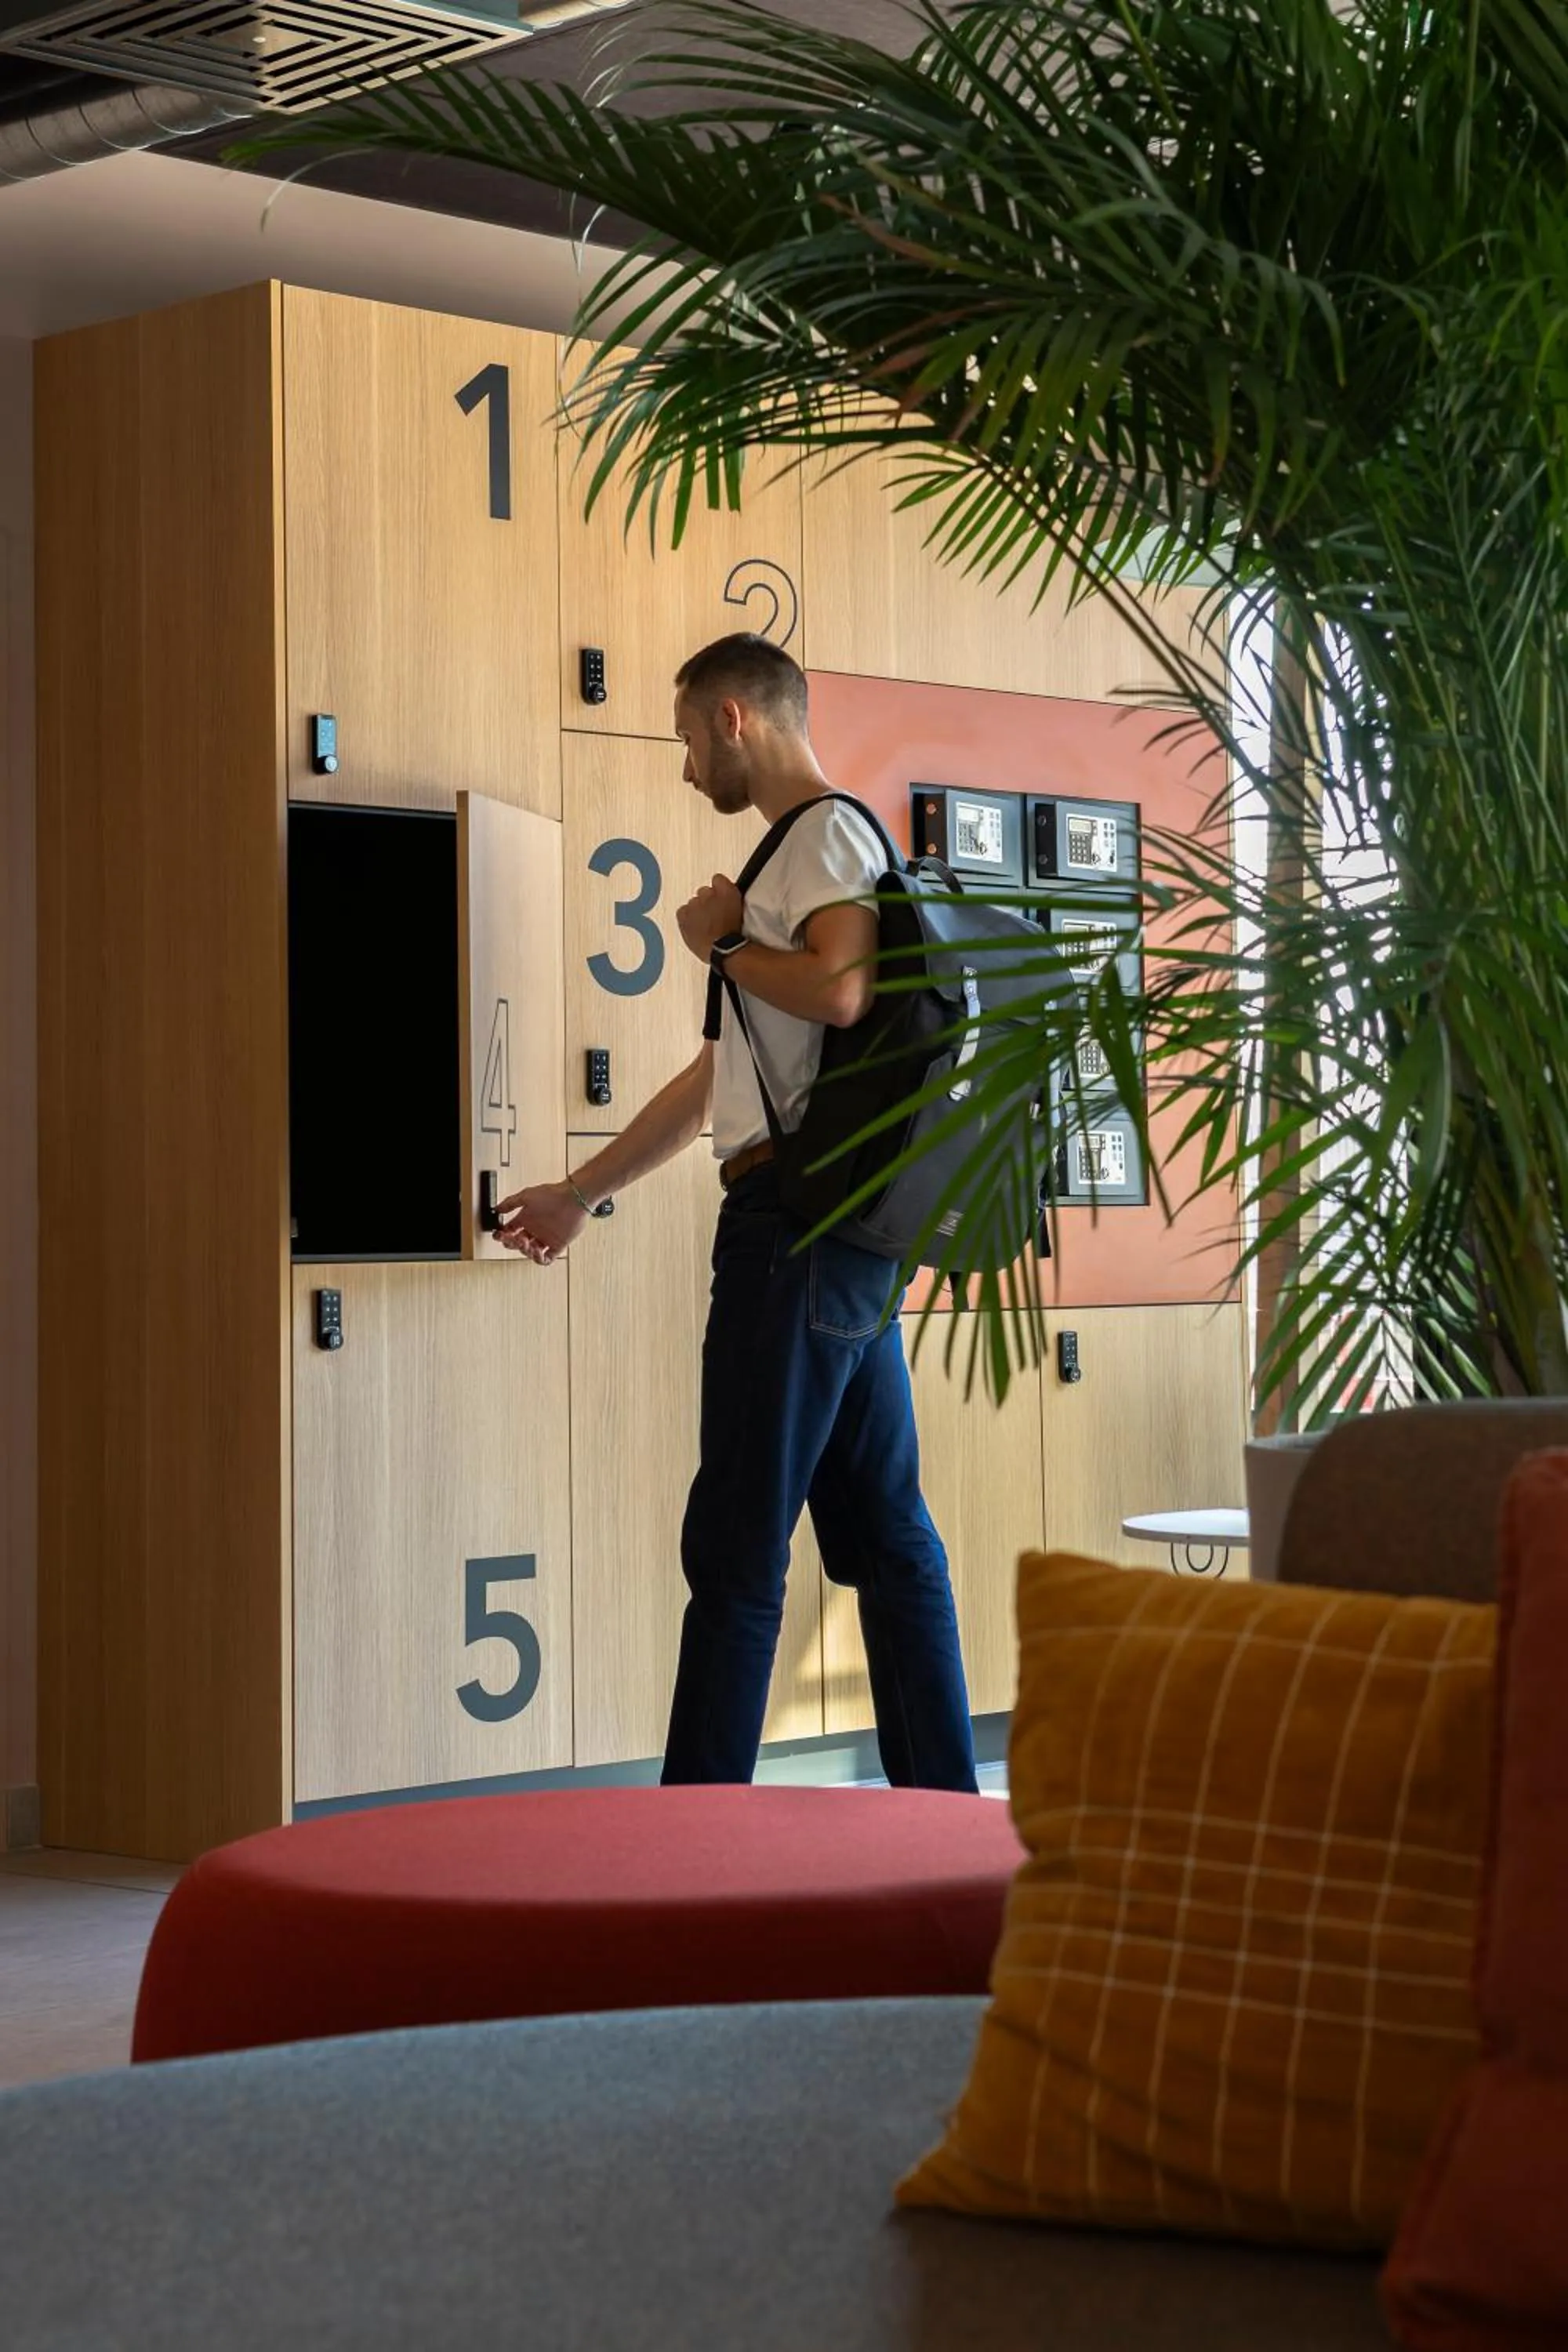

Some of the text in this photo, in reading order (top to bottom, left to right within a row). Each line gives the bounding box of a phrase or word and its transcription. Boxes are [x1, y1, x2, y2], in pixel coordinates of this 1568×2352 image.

[454, 363, 511, 520] 1
[586, 838, 665, 996] 3
[481, 998, 517, 1167] 4
[456, 1553, 542, 1722] 5
